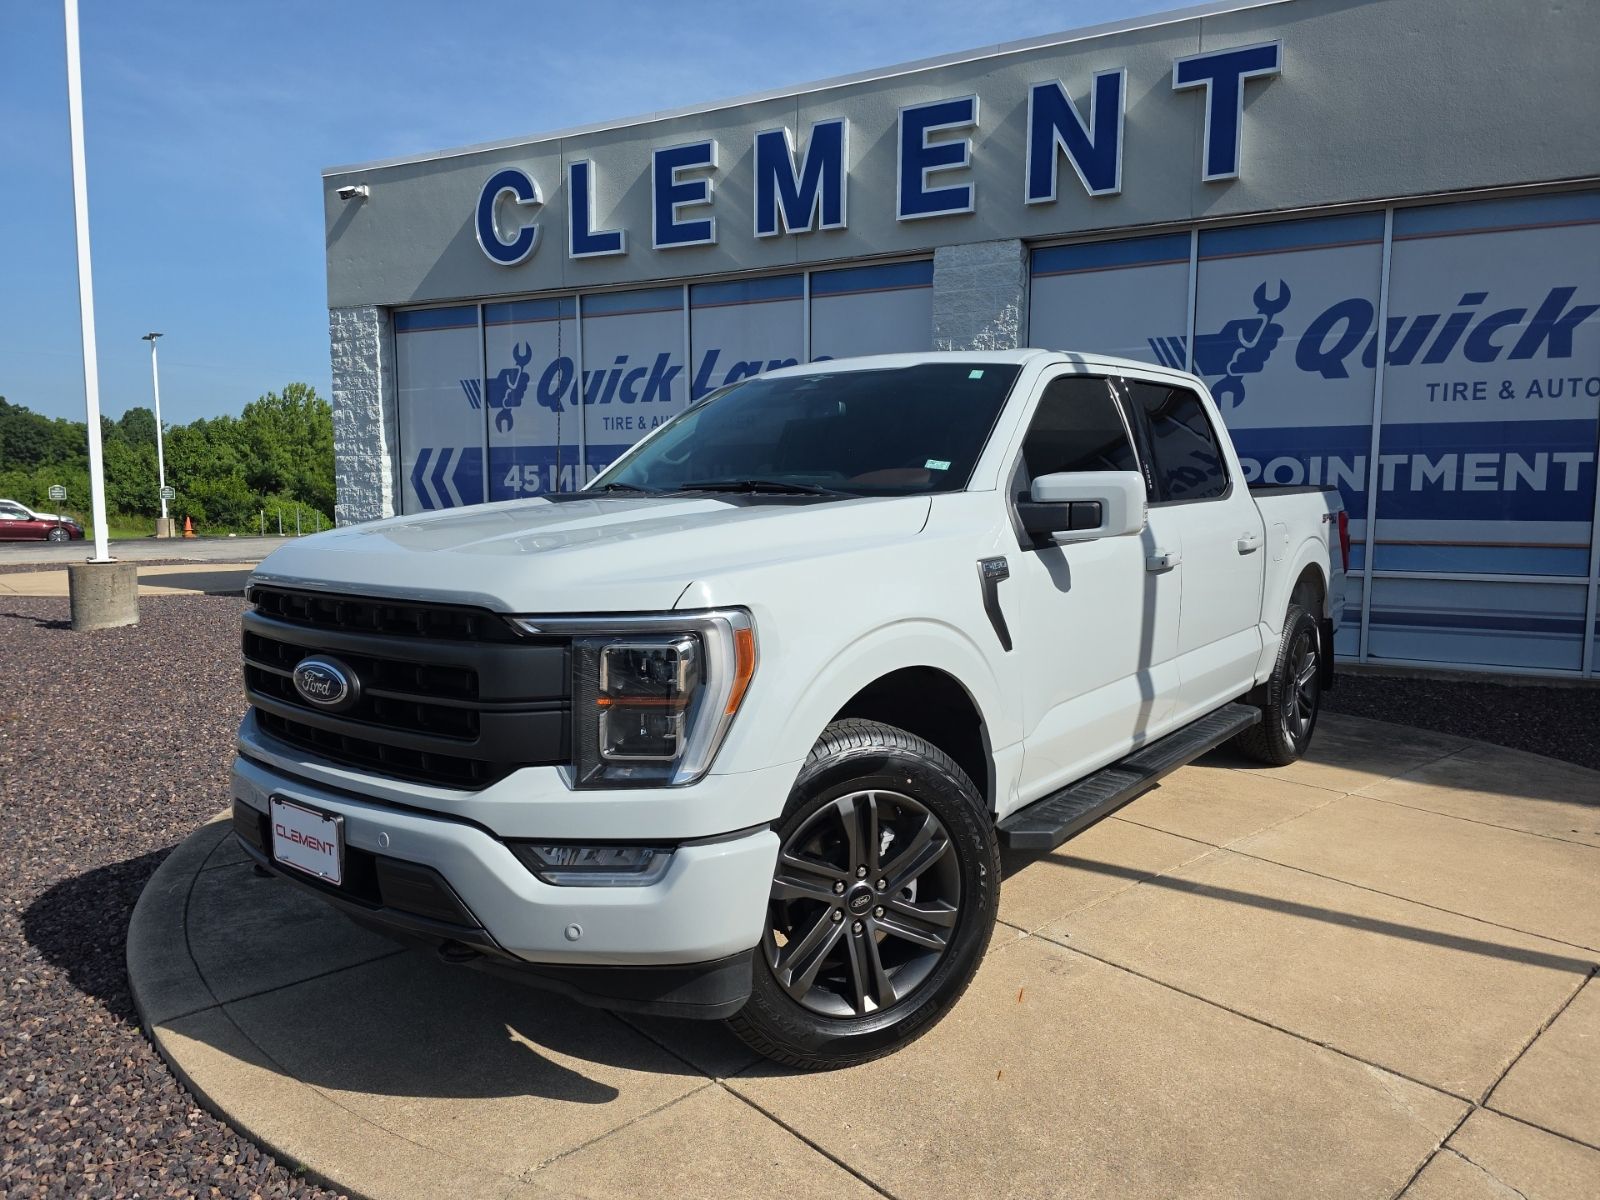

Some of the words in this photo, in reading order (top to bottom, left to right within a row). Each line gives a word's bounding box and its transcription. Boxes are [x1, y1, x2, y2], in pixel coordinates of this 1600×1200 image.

[474, 38, 1282, 268] CLEMENT
[1295, 285, 1600, 380] Quick
[536, 351, 685, 412] Quick
[691, 349, 834, 401] La
[1426, 380, 1488, 402] TIRE
[1498, 379, 1516, 400] &
[1525, 377, 1600, 400] AUTO
[603, 415, 633, 431] TIRE
[638, 415, 647, 430] &
[503, 464, 540, 492] 45
[302, 669, 331, 696] Ford
[275, 823, 335, 856] CLEMENT
